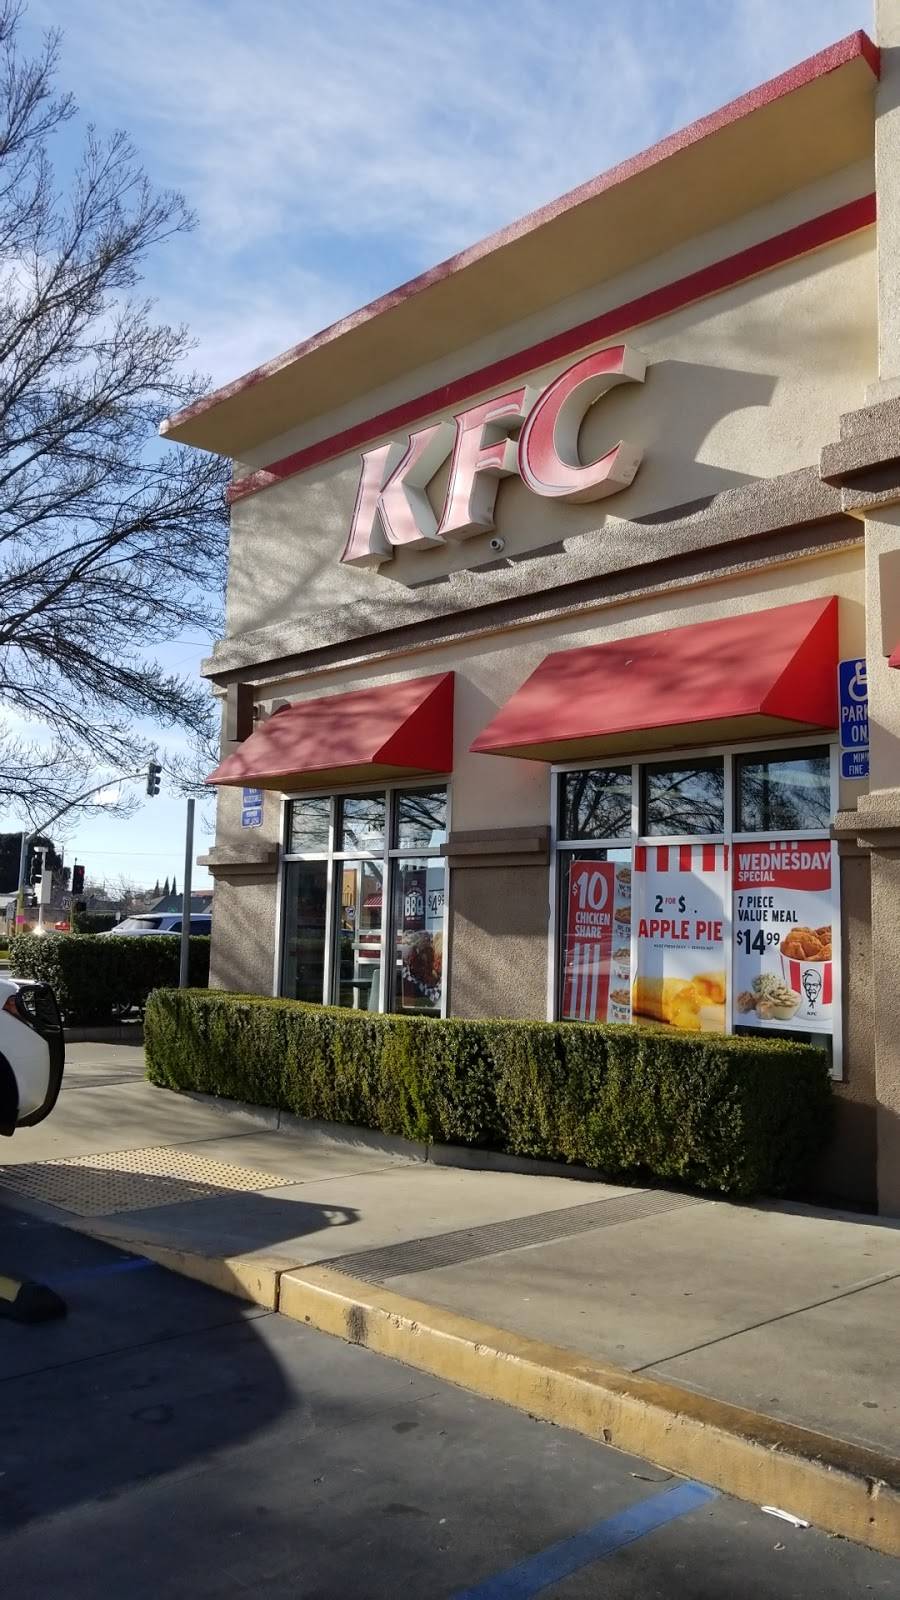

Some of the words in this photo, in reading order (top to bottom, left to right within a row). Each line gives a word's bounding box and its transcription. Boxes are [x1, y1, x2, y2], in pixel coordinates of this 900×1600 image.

[340, 344, 647, 567] KFC
[738, 851, 831, 871] WEDNESDAY
[738, 871, 775, 882] SPECIAL
[571, 871, 609, 911] $10
[654, 894, 664, 913] 2
[738, 896, 743, 908] 7
[746, 896, 774, 908] PIECE
[575, 911, 611, 925] CHICKEN
[738, 909, 768, 922] VALUE
[771, 910, 798, 923] MEAL
[574, 924, 602, 939] SHARE
[638, 918, 690, 940] APPLE
[696, 920, 723, 941] PIE
